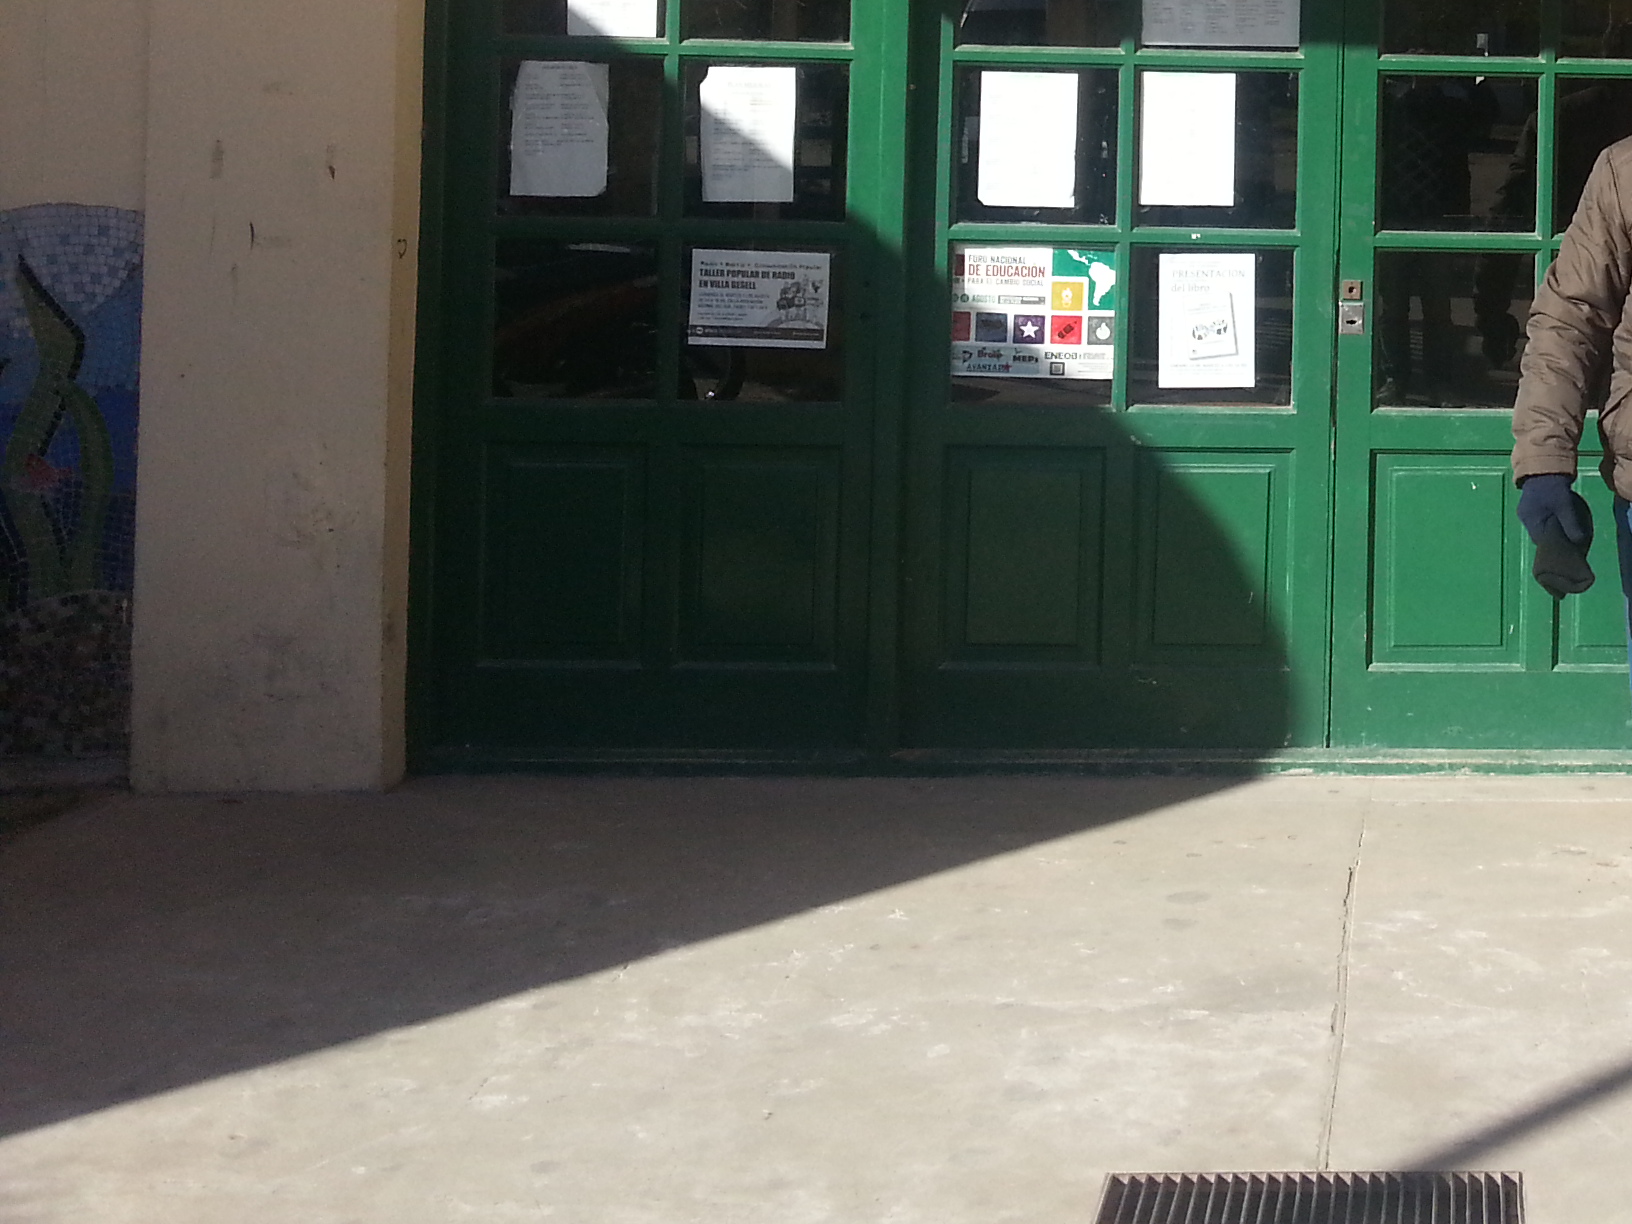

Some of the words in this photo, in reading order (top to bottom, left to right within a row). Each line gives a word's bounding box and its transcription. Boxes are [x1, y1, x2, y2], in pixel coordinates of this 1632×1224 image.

[968, 254, 988, 264] FORO
[990, 256, 1026, 265] NACIONAL
[699, 268, 725, 277] TALLER
[726, 269, 760, 278] POPULAR
[761, 271, 770, 279] DE
[771, 271, 796, 280] RADIO
[968, 263, 982, 276] DE
[985, 262, 1046, 278] EDUCACIÓN
[699, 279, 709, 288] EN
[710, 279, 730, 289] VILLA
[731, 280, 757, 290] GESELL
[967, 277, 984, 285] PARA
[995, 278, 1020, 286] CAMBIO
[1022, 279, 1044, 287] SOCIAL
[1171, 283, 1185, 292] del
[1187, 283, 1211, 293] libro
